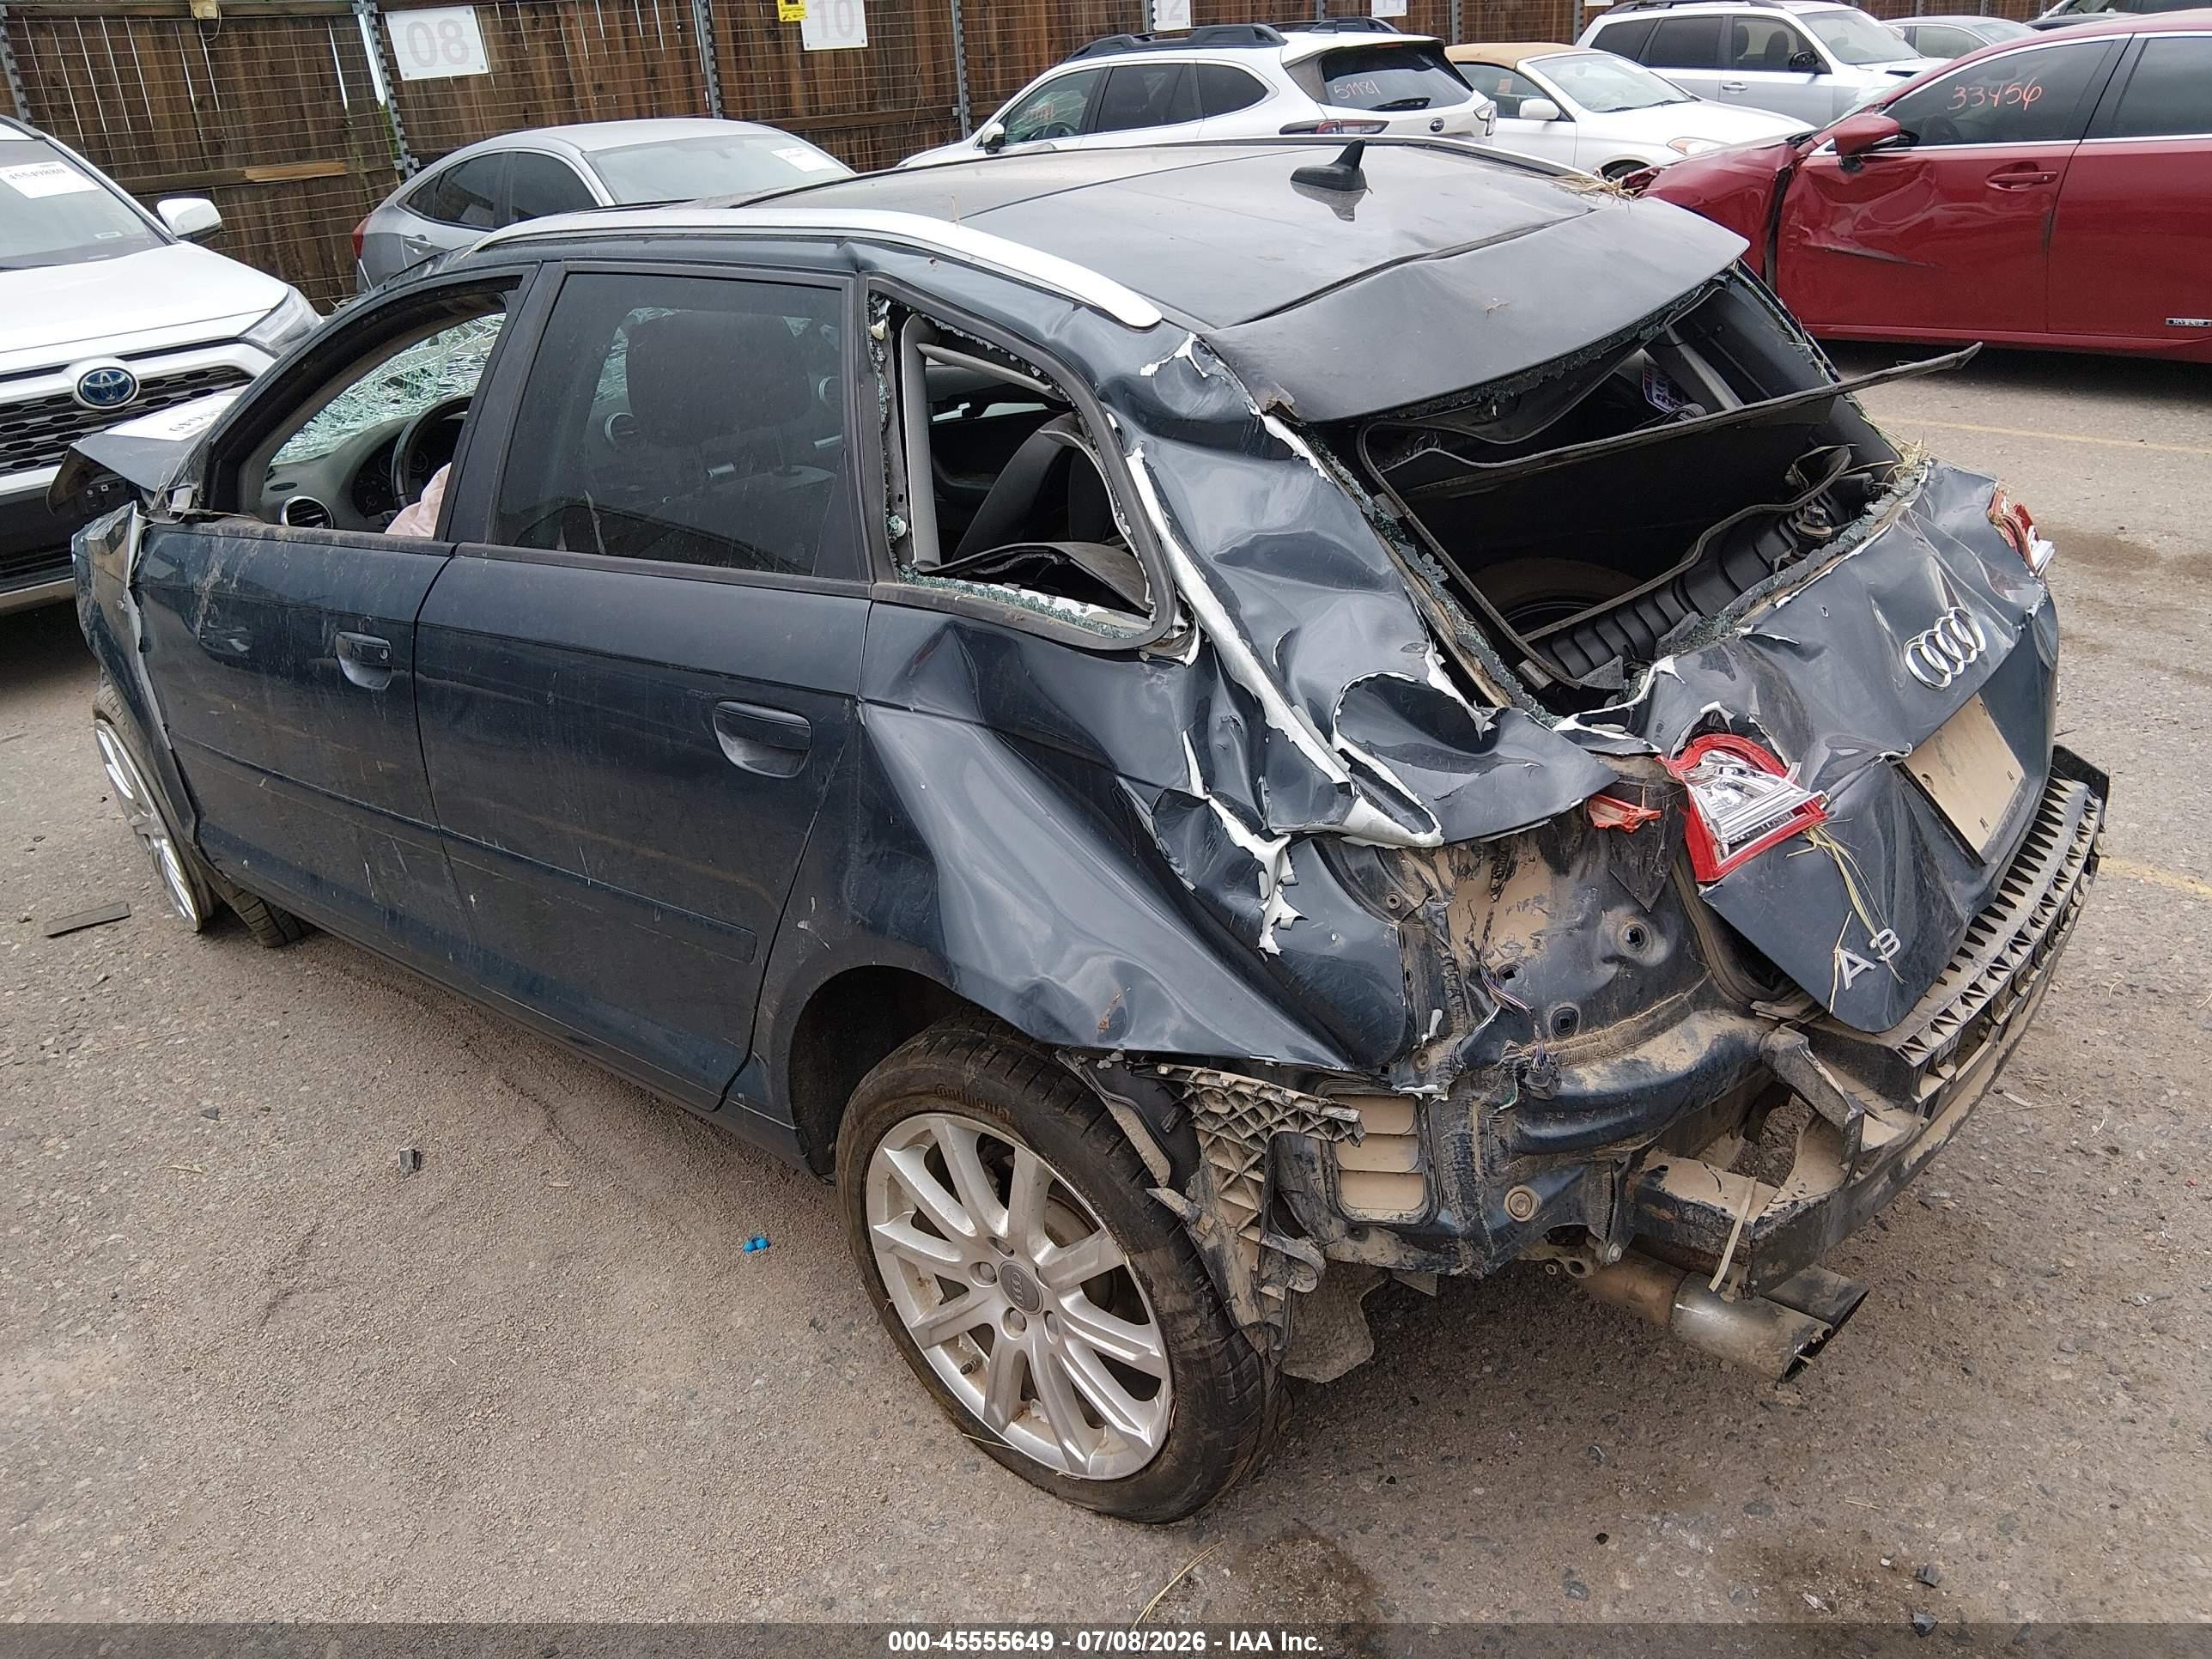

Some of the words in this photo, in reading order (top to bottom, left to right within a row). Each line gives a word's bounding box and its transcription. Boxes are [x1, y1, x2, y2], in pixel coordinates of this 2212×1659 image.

[811, 0, 855, 39] 10
[406, 18, 470, 68] 08
[1947, 76, 2043, 111] 33456
[1837, 927, 1901, 992] A3
